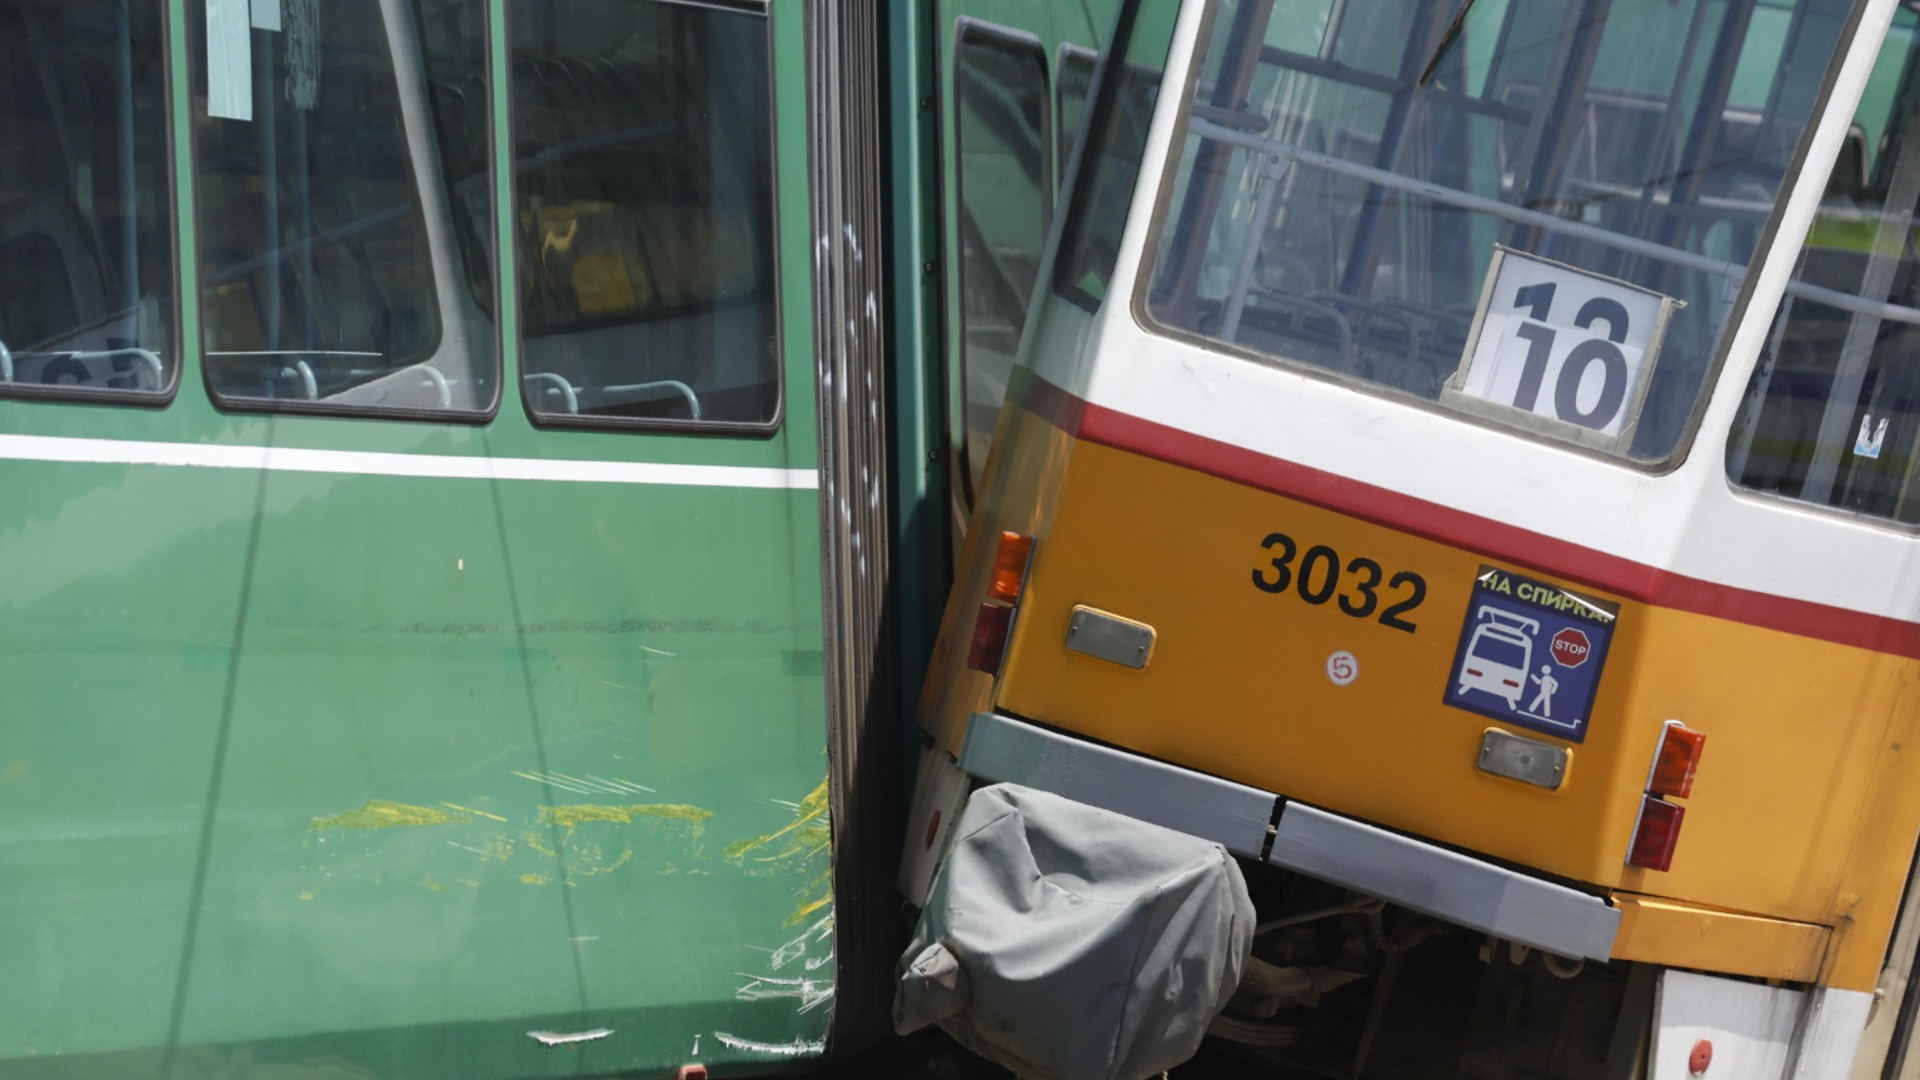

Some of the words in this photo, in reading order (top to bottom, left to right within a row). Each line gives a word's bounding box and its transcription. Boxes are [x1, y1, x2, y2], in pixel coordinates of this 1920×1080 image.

[1512, 321, 1627, 431] 10
[1252, 533, 1427, 634] 3032
[1481, 574, 1511, 595] НА
[1555, 640, 1586, 655] STOP
[1332, 656, 1353, 680] 5
